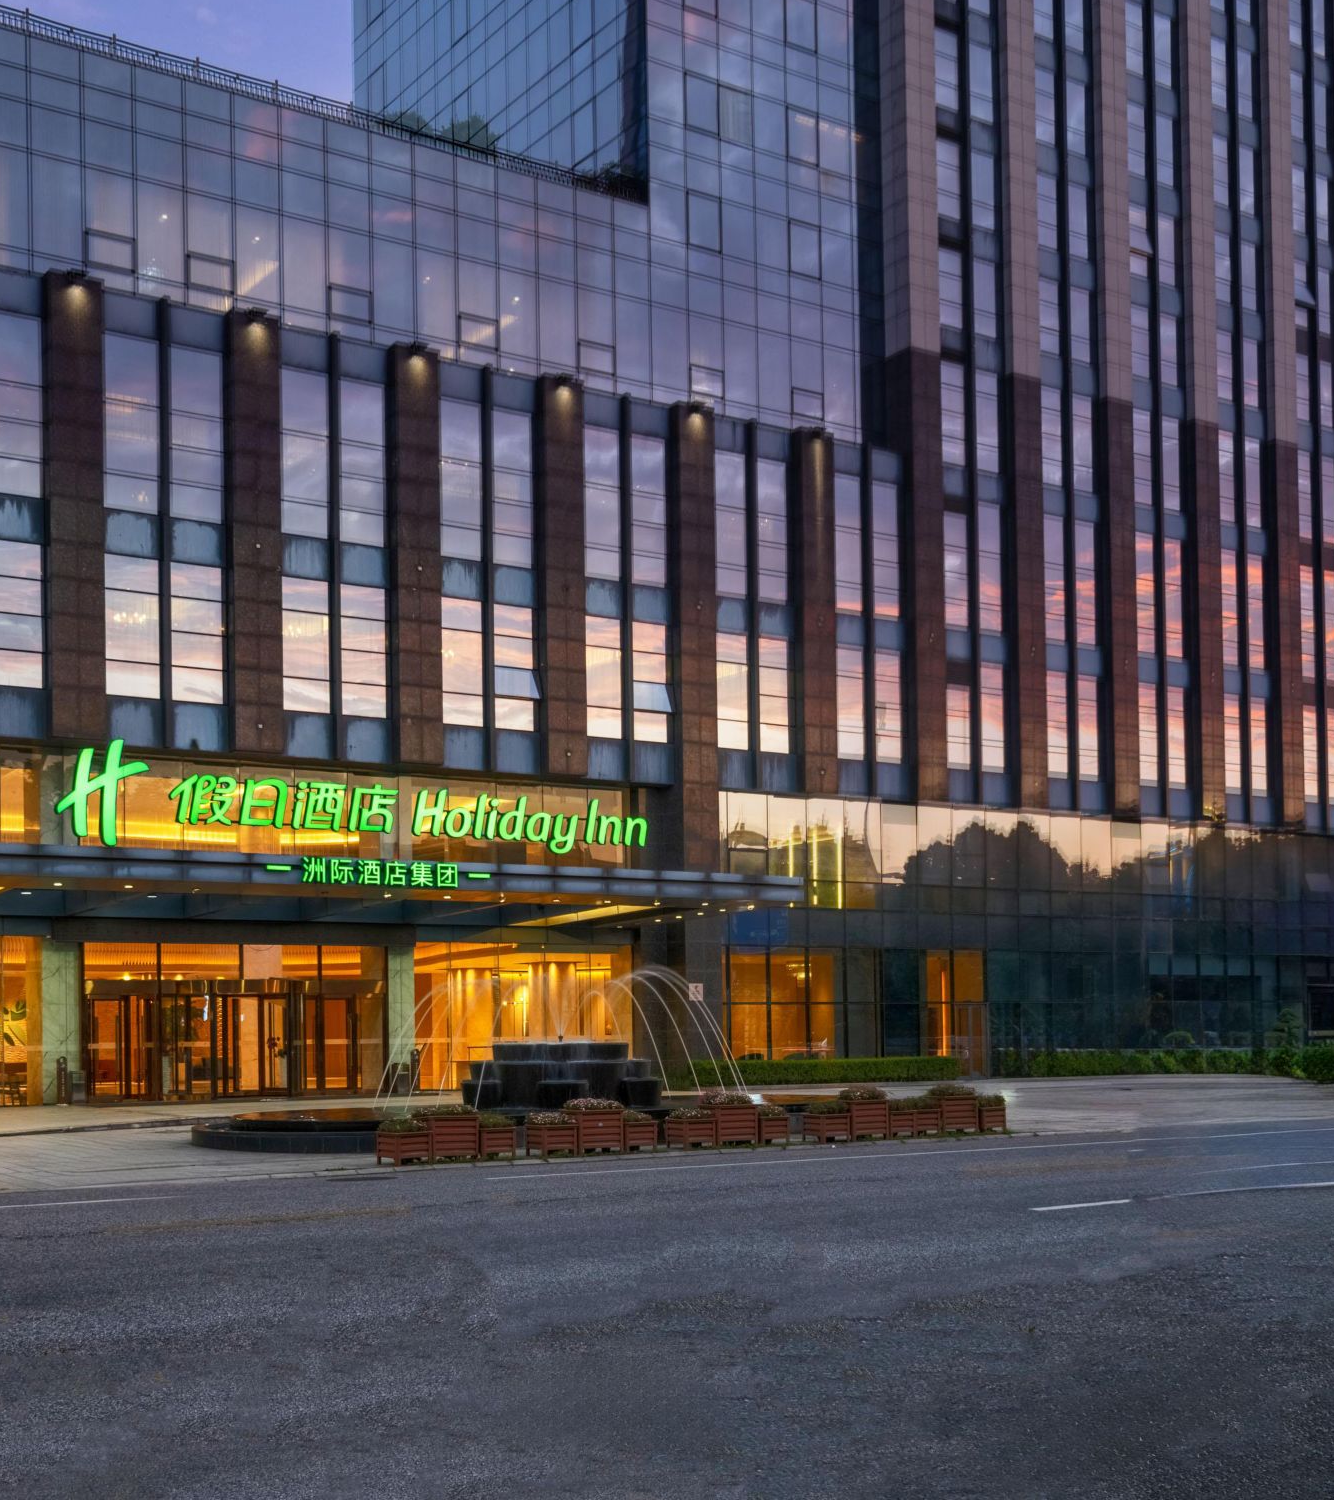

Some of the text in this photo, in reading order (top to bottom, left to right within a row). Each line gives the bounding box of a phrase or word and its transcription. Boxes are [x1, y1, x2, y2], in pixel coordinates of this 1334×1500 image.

[168, 773, 400, 835] 假日酒店
[411, 787, 649, 855] Holiday Inn
[301, 856, 460, 889] 洲际酒店集团
